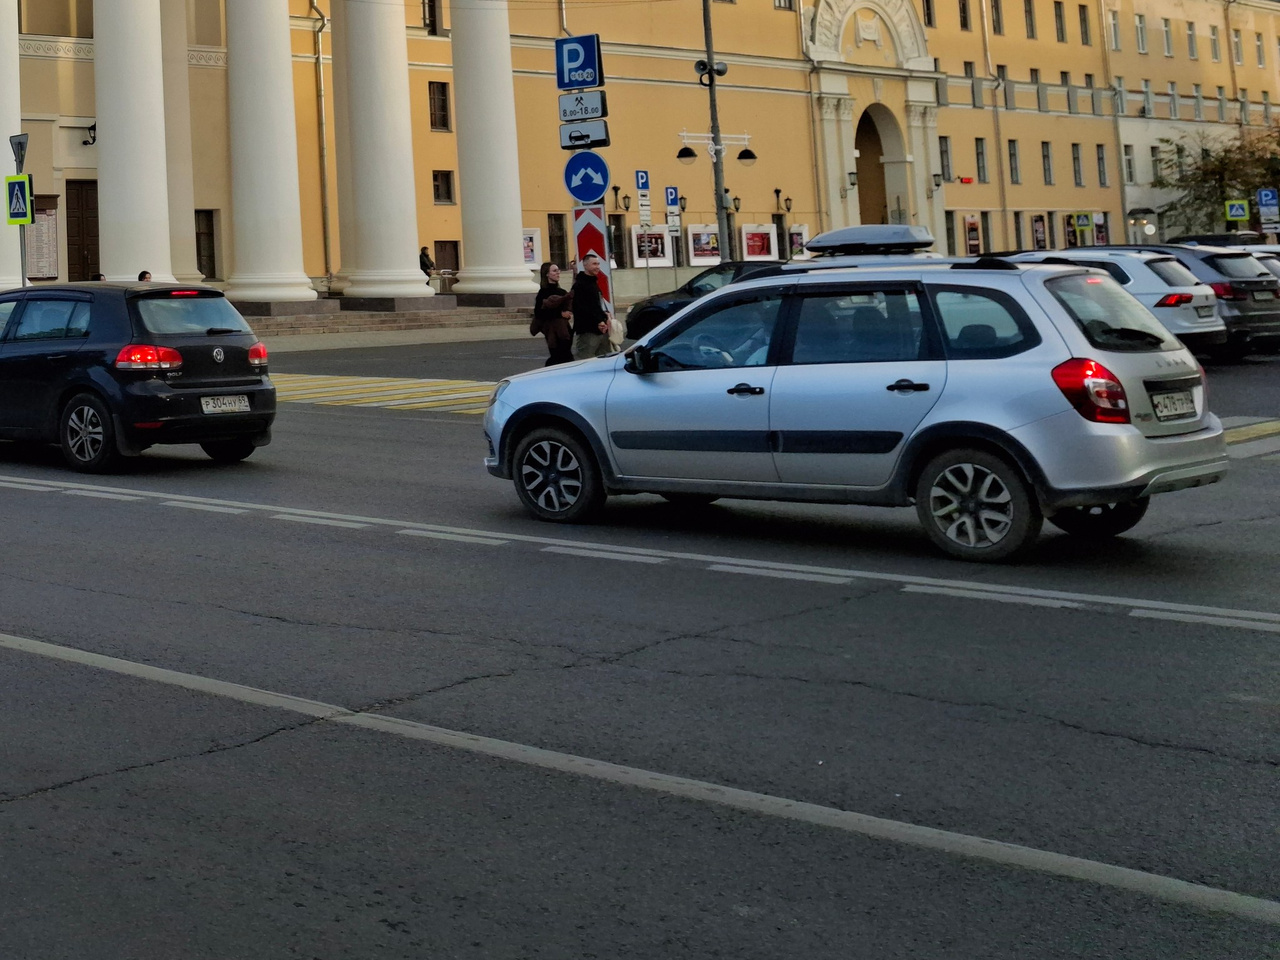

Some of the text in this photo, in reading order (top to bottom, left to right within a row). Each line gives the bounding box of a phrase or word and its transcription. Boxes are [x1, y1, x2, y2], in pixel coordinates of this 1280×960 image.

[562, 42, 585, 84] P
[586, 71, 594, 79] 20
[562, 106, 600, 118] 8.00-18.00
[638, 172, 647, 188] P
[667, 188, 676, 204] P
[1261, 190, 1273, 205] P
[204, 395, 237, 410] Р304НУ
